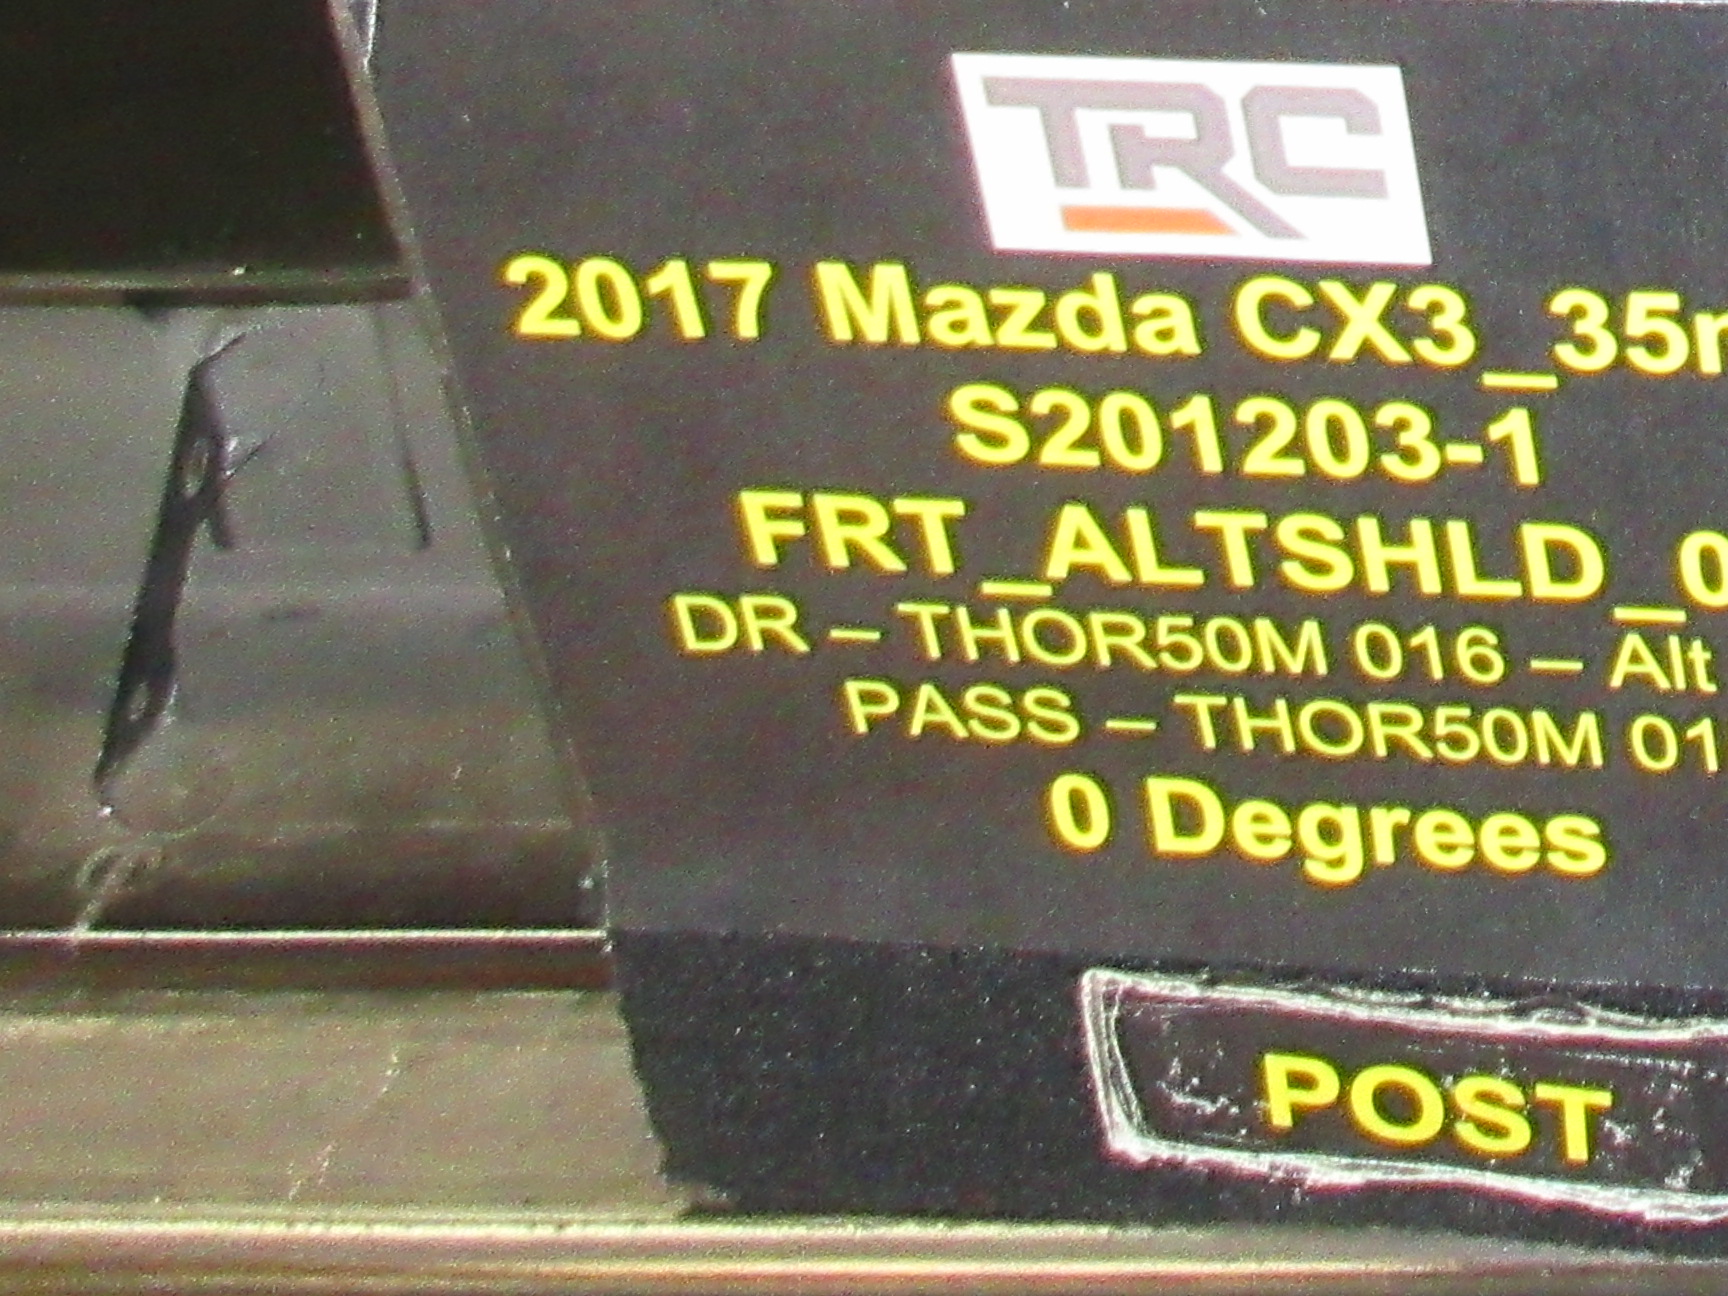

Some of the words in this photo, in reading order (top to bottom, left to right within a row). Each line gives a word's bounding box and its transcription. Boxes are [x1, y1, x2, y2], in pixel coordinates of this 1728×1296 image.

[983, 77, 1388, 238] TRC
[501, 251, 772, 342] 2017
[811, 258, 1203, 359] Mazda
[943, 380, 1541, 488] S201203-1
[668, 592, 809, 656] DR
[895, 600, 1329, 676] THOR50M
[1347, 620, 1506, 687] 016
[1608, 633, 1718, 694] Alt
[842, 678, 1081, 746] PASS
[1172, 691, 1605, 768] THOR50M
[1046, 770, 1111, 853] 0
[1141, 774, 1607, 886] Degrees
[1259, 1051, 1614, 1163] POST
